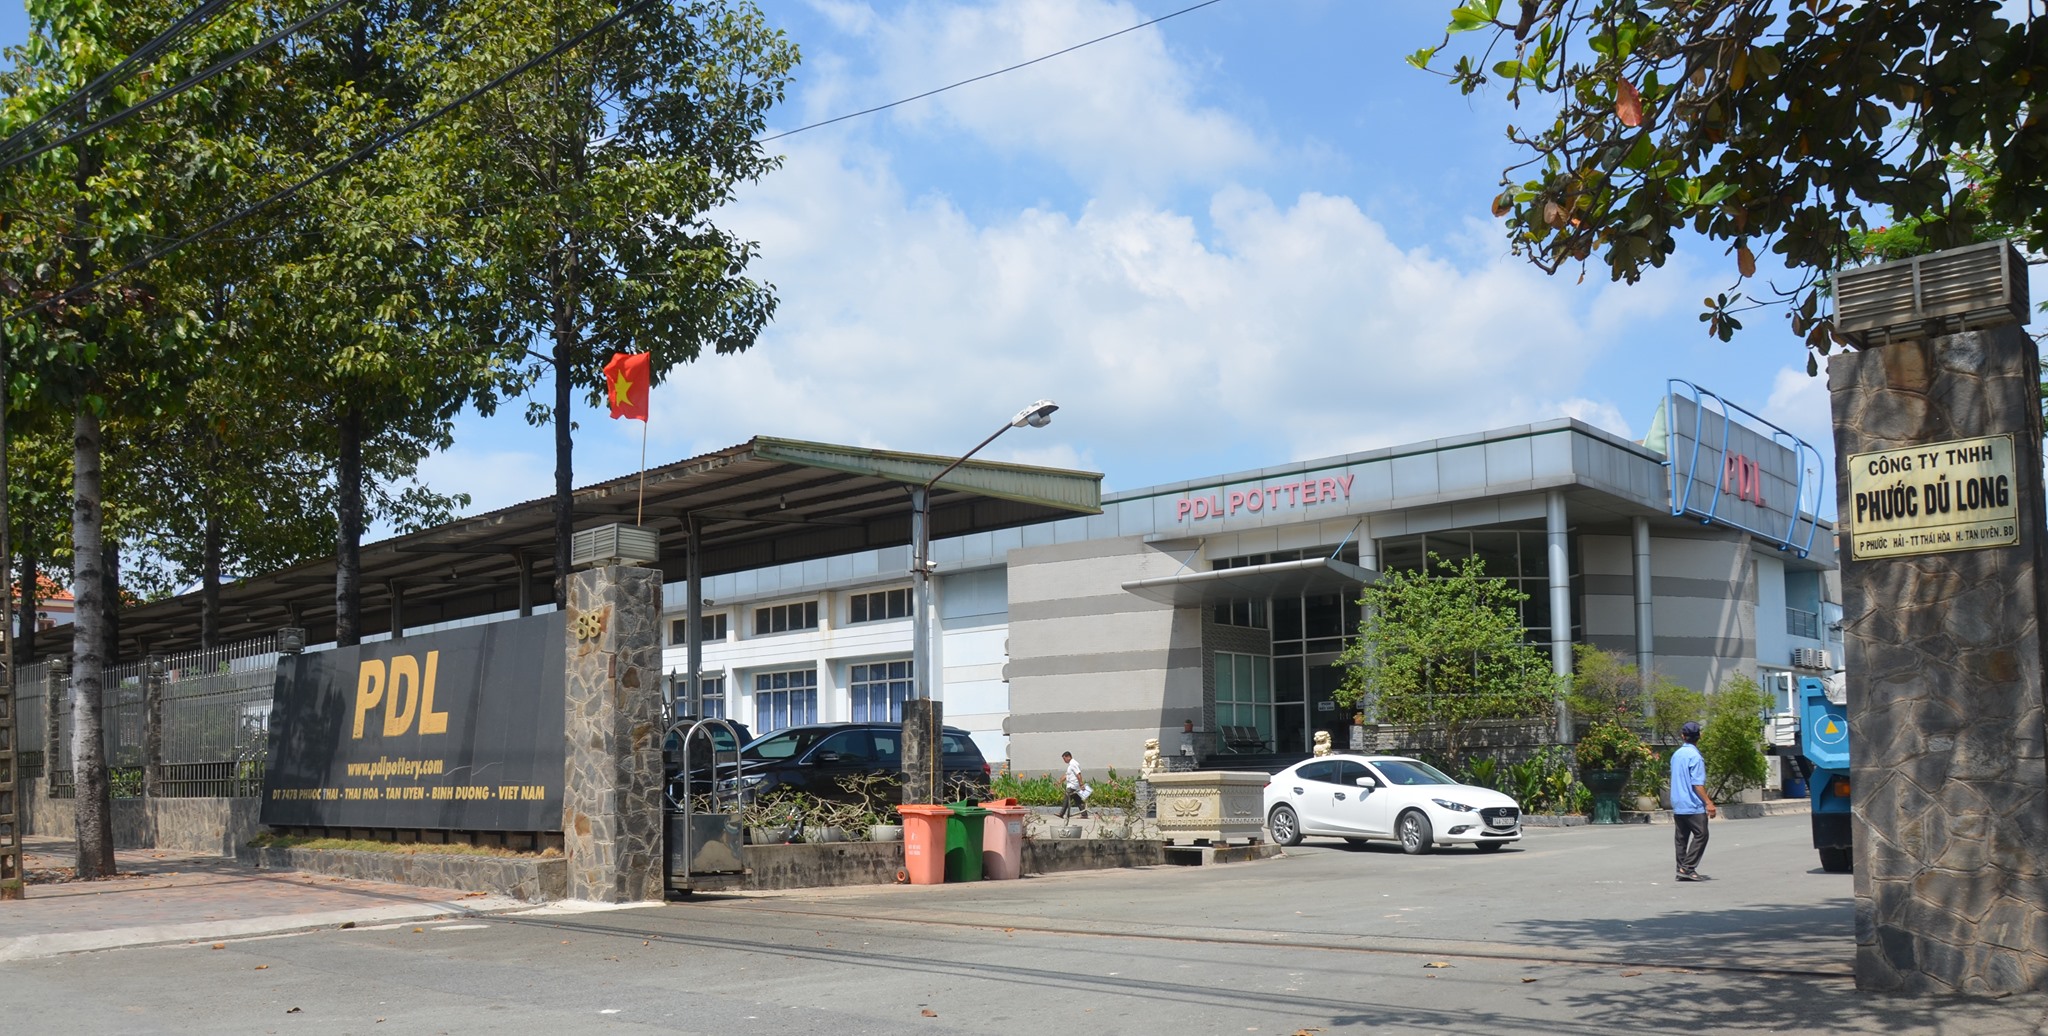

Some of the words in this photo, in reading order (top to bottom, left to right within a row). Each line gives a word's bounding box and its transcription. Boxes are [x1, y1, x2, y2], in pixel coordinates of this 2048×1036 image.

[1868, 455, 1912, 476] CÔNG
[1918, 452, 1939, 469] TY
[1946, 445, 1993, 465] TNHH
[1723, 449, 1767, 508] PDL
[1176, 494, 1224, 521] PDL
[1229, 474, 1355, 515] POTTERY
[1855, 479, 1918, 524] PHƯỚC
[1923, 473, 1950, 515] DŨ
[1956, 474, 2009, 512] LONG
[1910, 535, 1919, 546] TT
[576, 612, 601, 640] 88
[352, 650, 449, 740] PDL
[347, 756, 444, 781] www.pdlpottery.com
[272, 789, 281, 800] DT
[298, 788, 322, 800] PHUOC
[322, 788, 339, 800] THAI
[345, 788, 361, 800] THAI
[362, 788, 379, 800] HOA
[385, 787, 402, 800] TAN
[402, 787, 424, 799] UYEN
[431, 786, 454, 800] BINH
[455, 786, 489, 800] DUONG
[498, 786, 519, 800] VIET
[521, 786, 545, 800] NAM
